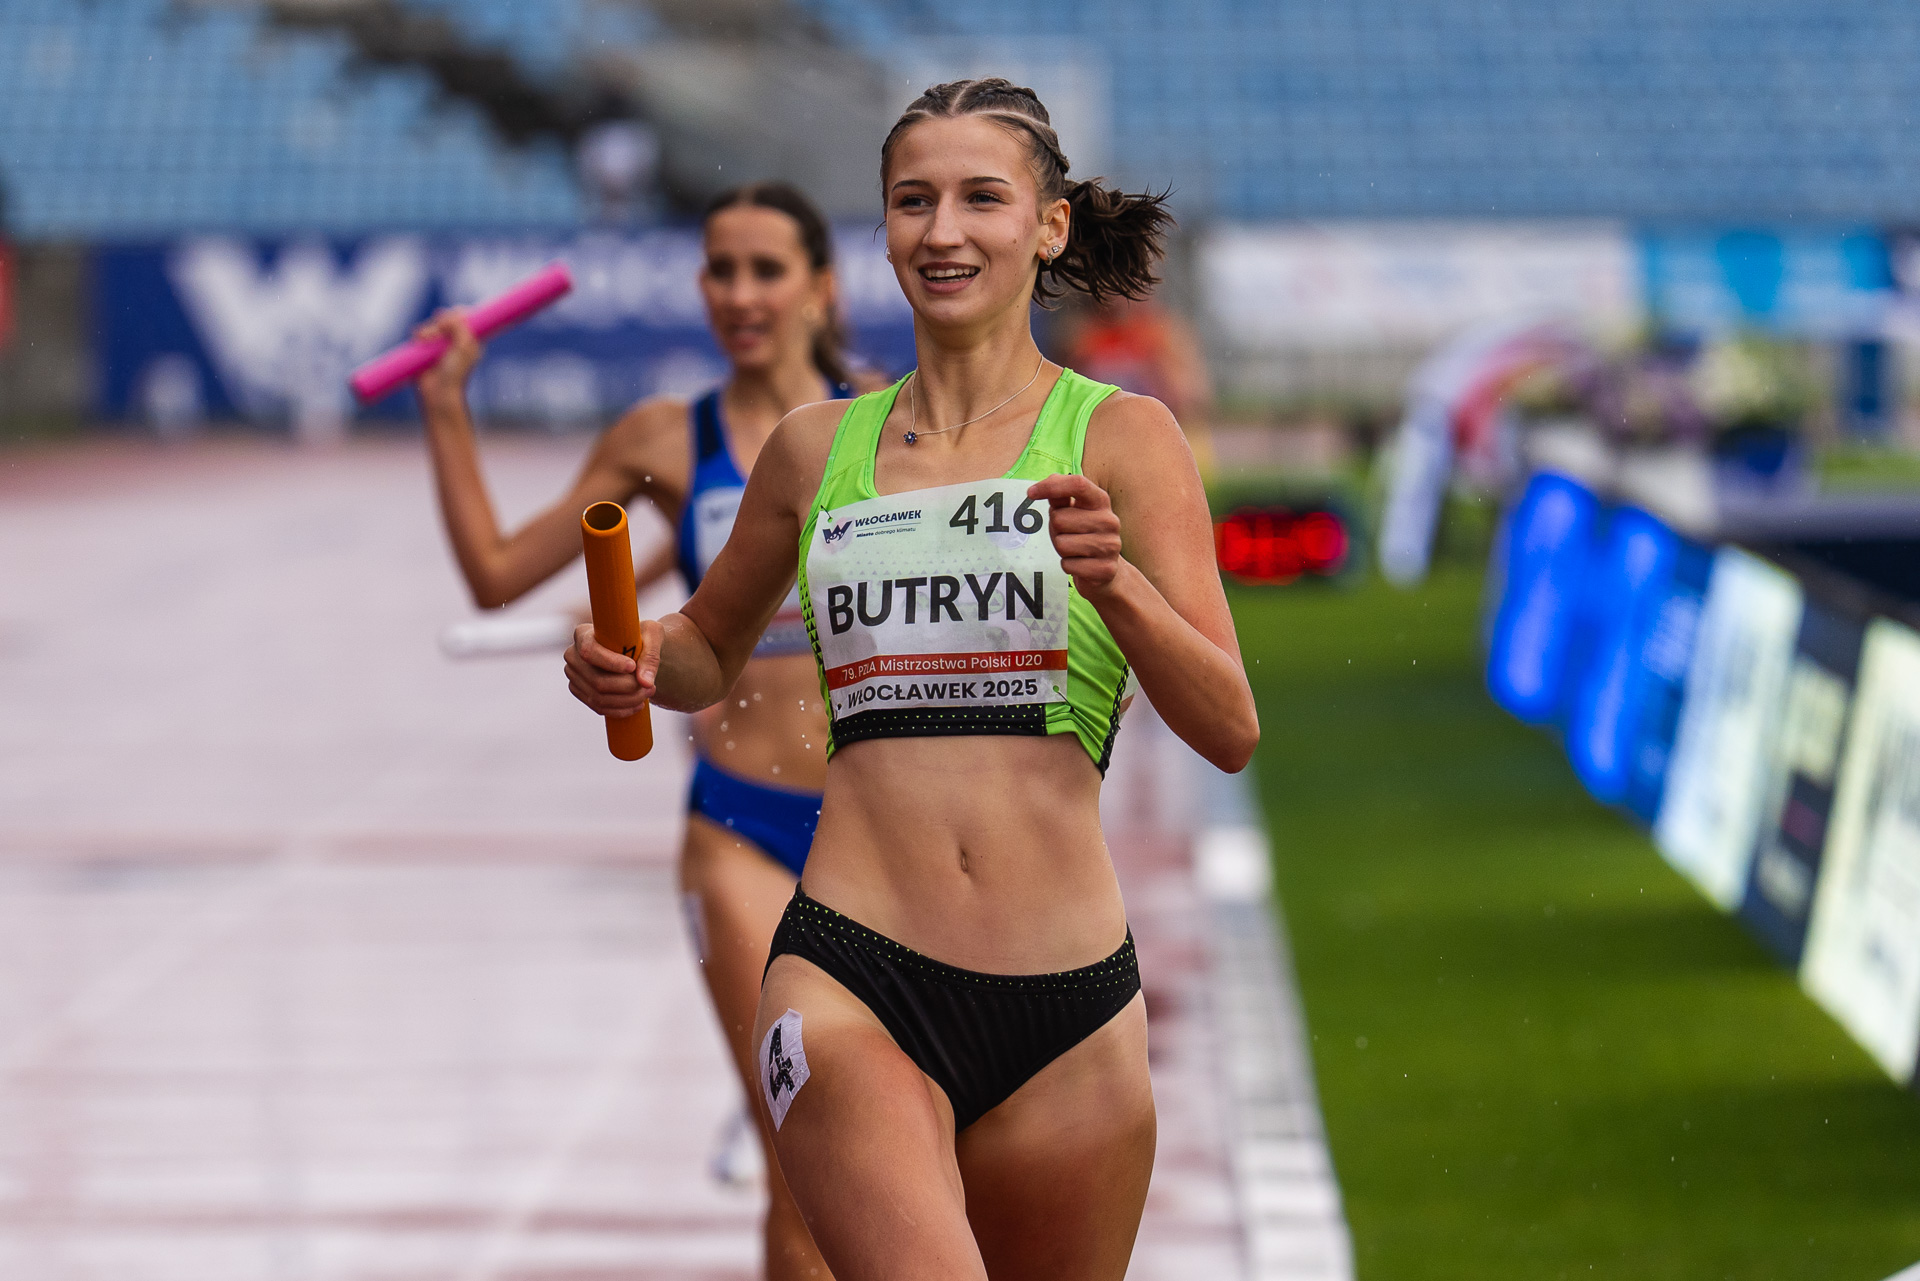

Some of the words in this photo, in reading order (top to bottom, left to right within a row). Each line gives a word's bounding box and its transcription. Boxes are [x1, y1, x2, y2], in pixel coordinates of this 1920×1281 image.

[854, 509, 922, 528] WŁOCŁAWEK
[948, 491, 1044, 535] 416
[827, 571, 1044, 635] BUTRYN
[842, 668, 857, 681] 79.
[879, 657, 967, 672] Mistrzostwa
[970, 655, 1011, 669] Polski
[1015, 654, 1043, 667] U20
[848, 682, 977, 709] WŁOCŁAWEK
[982, 678, 1038, 698] 2025
